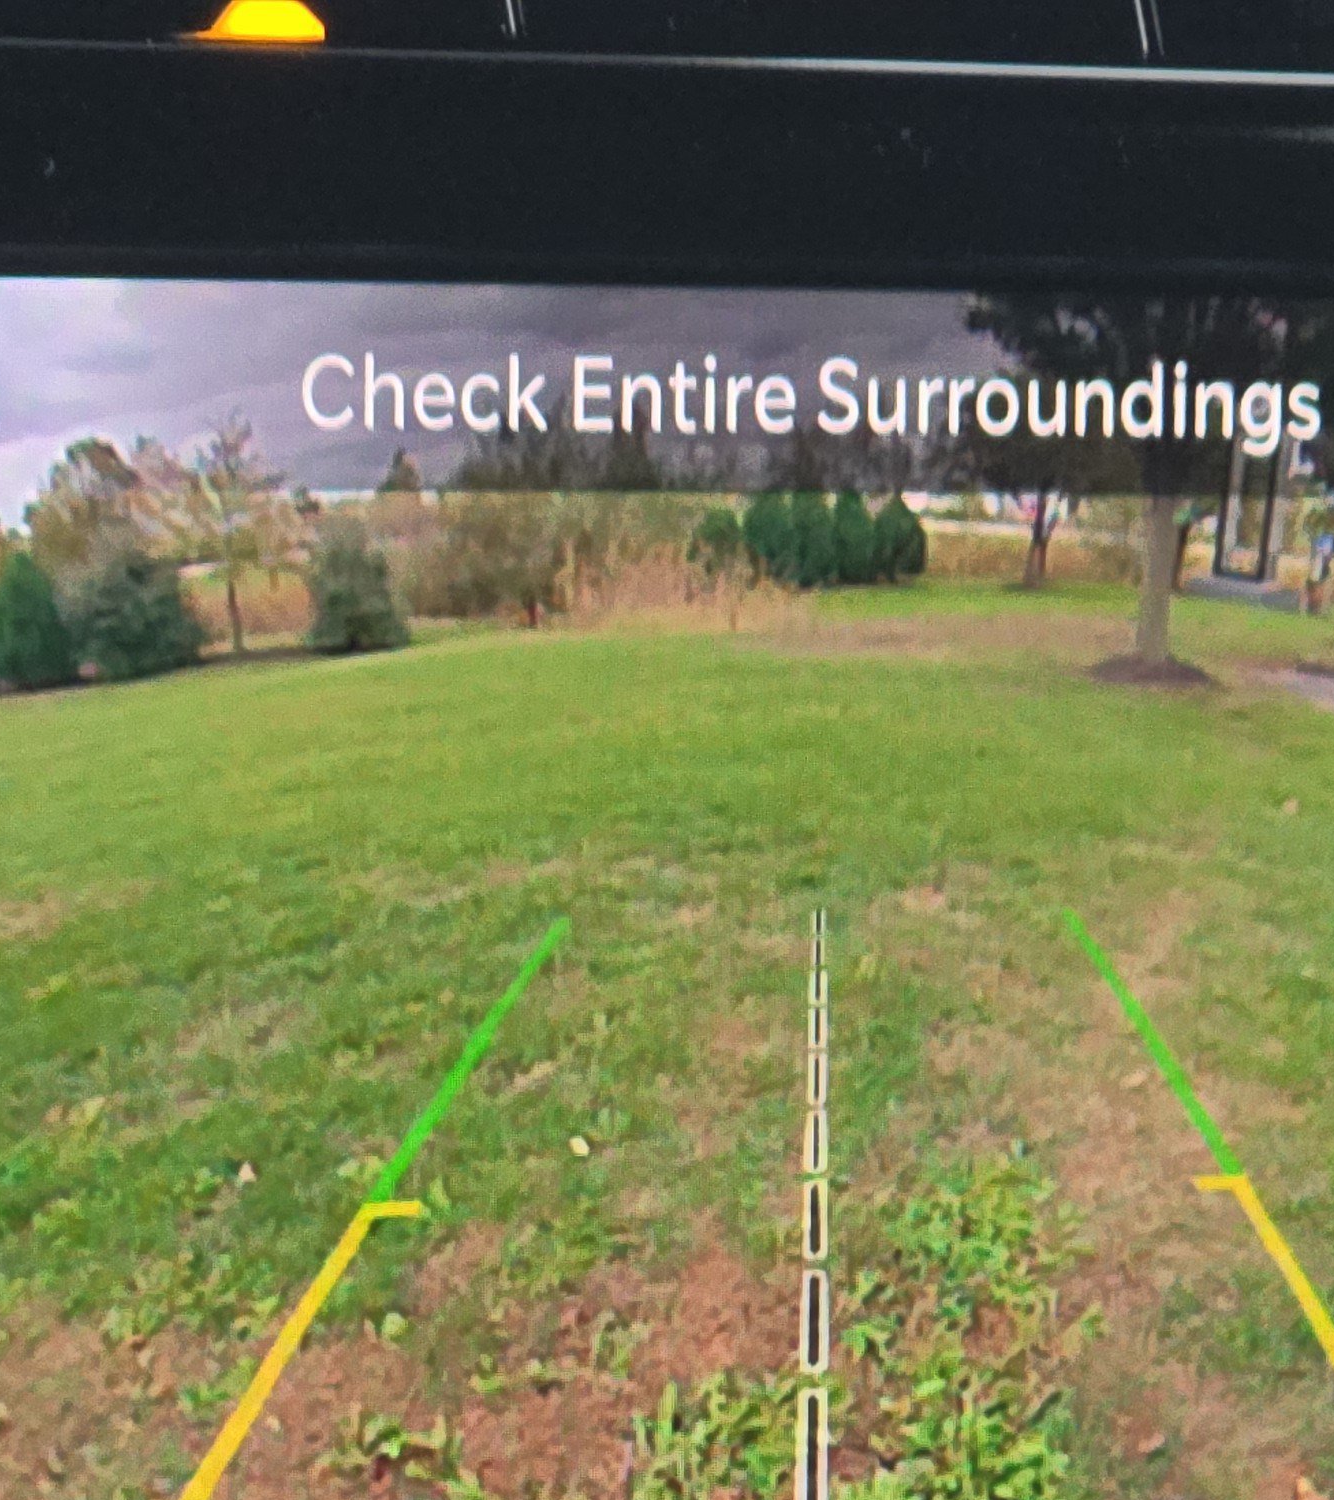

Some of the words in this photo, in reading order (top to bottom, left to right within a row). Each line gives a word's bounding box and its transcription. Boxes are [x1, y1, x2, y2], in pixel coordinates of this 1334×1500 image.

[299, 350, 549, 434] Check
[572, 352, 798, 435] Entire
[815, 356, 1323, 458] Surroundings
